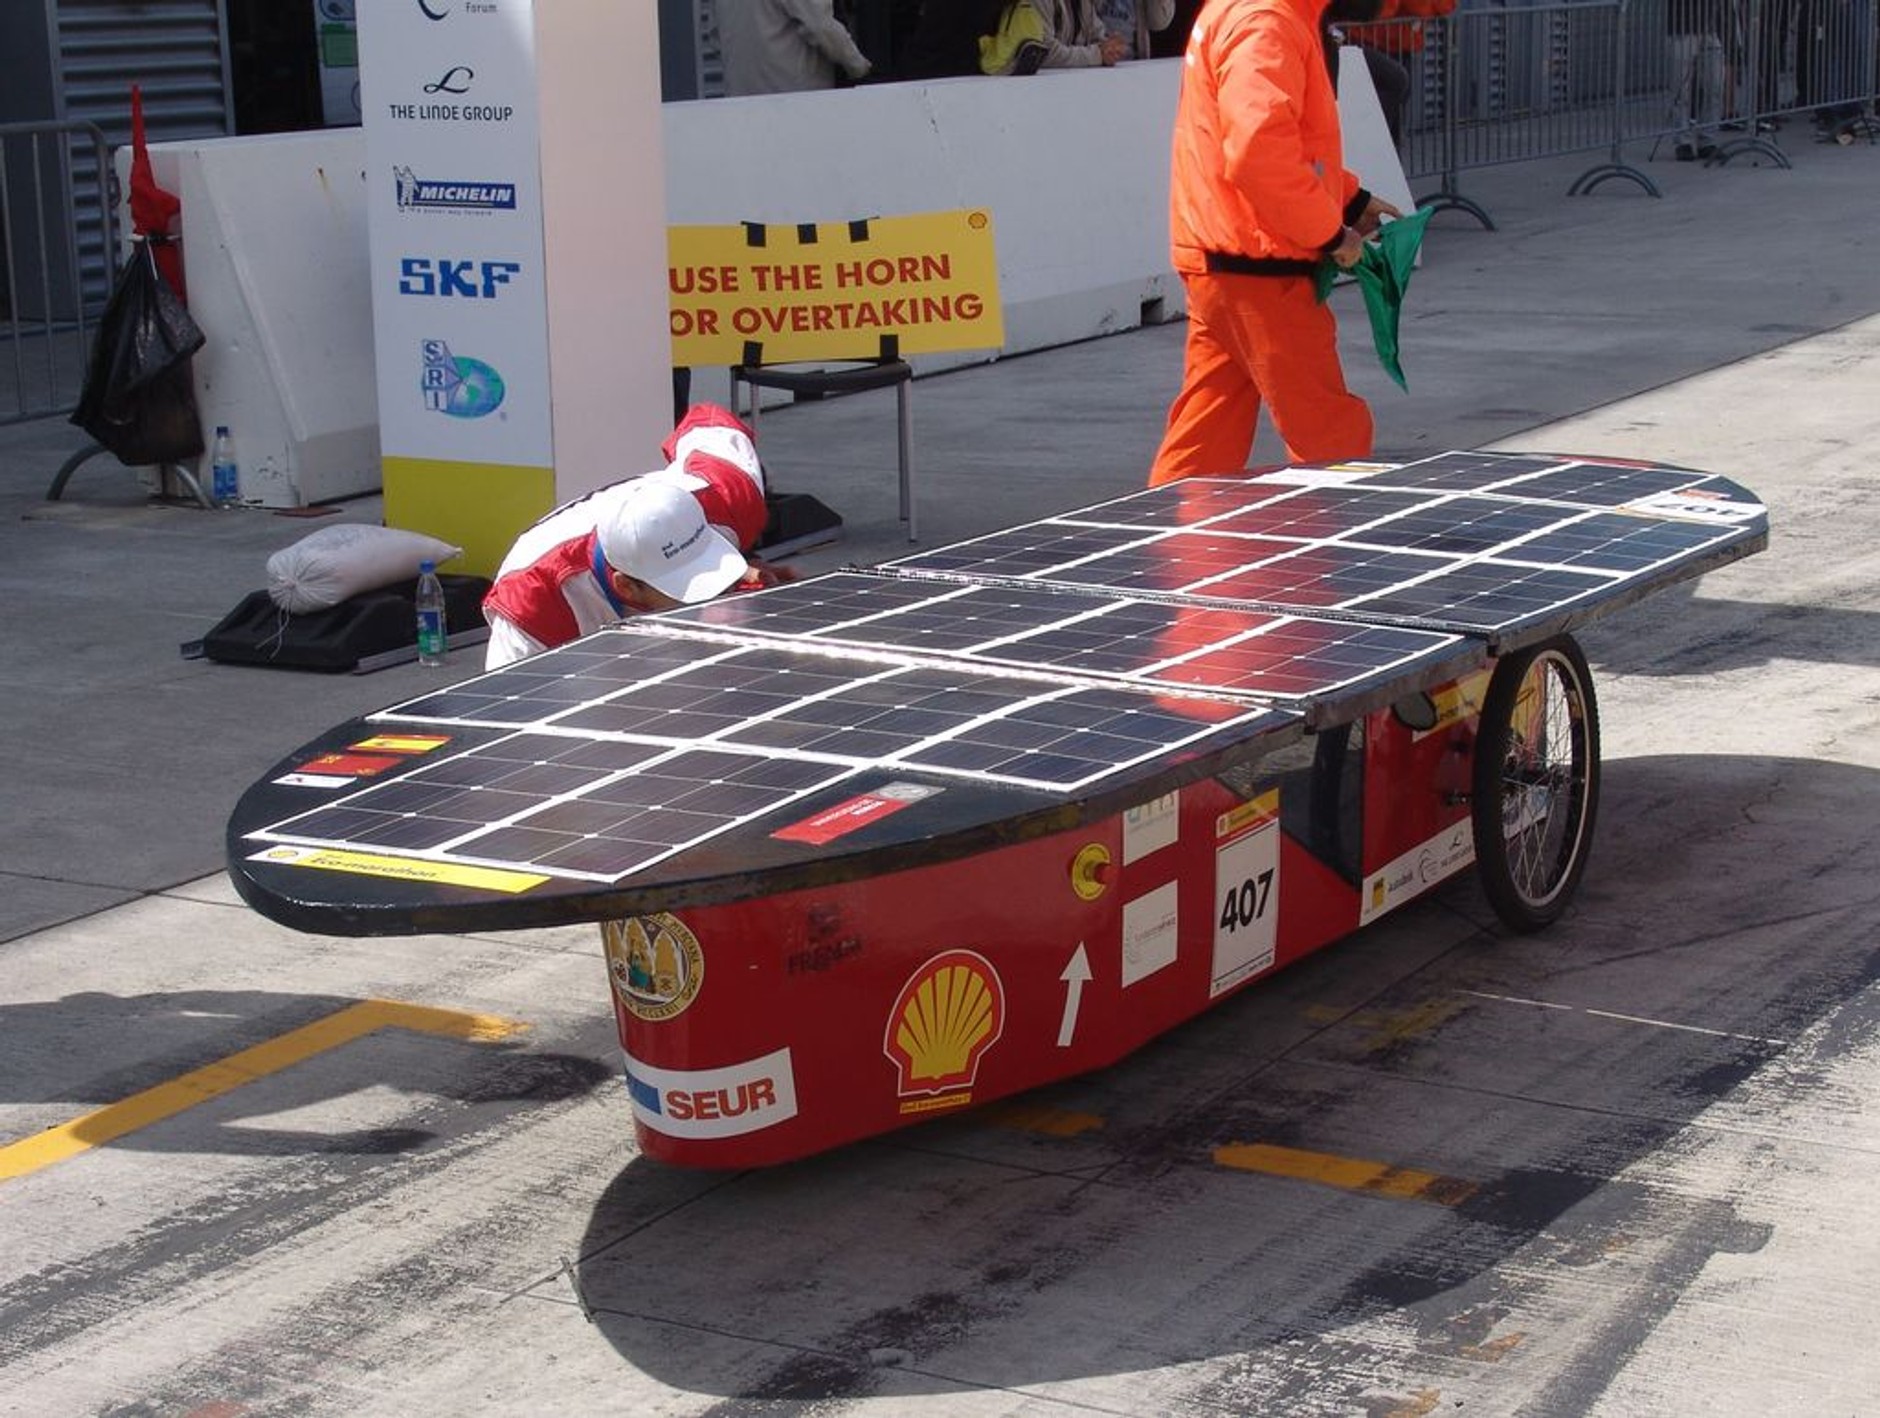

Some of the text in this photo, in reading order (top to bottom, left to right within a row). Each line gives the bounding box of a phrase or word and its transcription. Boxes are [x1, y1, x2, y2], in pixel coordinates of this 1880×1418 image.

[465, 2, 497, 13] Forum
[390, 104, 416, 119] THE
[463, 106, 513, 121] GROUP
[420, 186, 512, 202] MICHELIN
[400, 258, 520, 299] SKF
[669, 253, 951, 295] USE THE HORN
[732, 293, 984, 335] OVERTAKING
[1220, 867, 1275, 934] 407
[665, 1077, 776, 1121] SEUR
